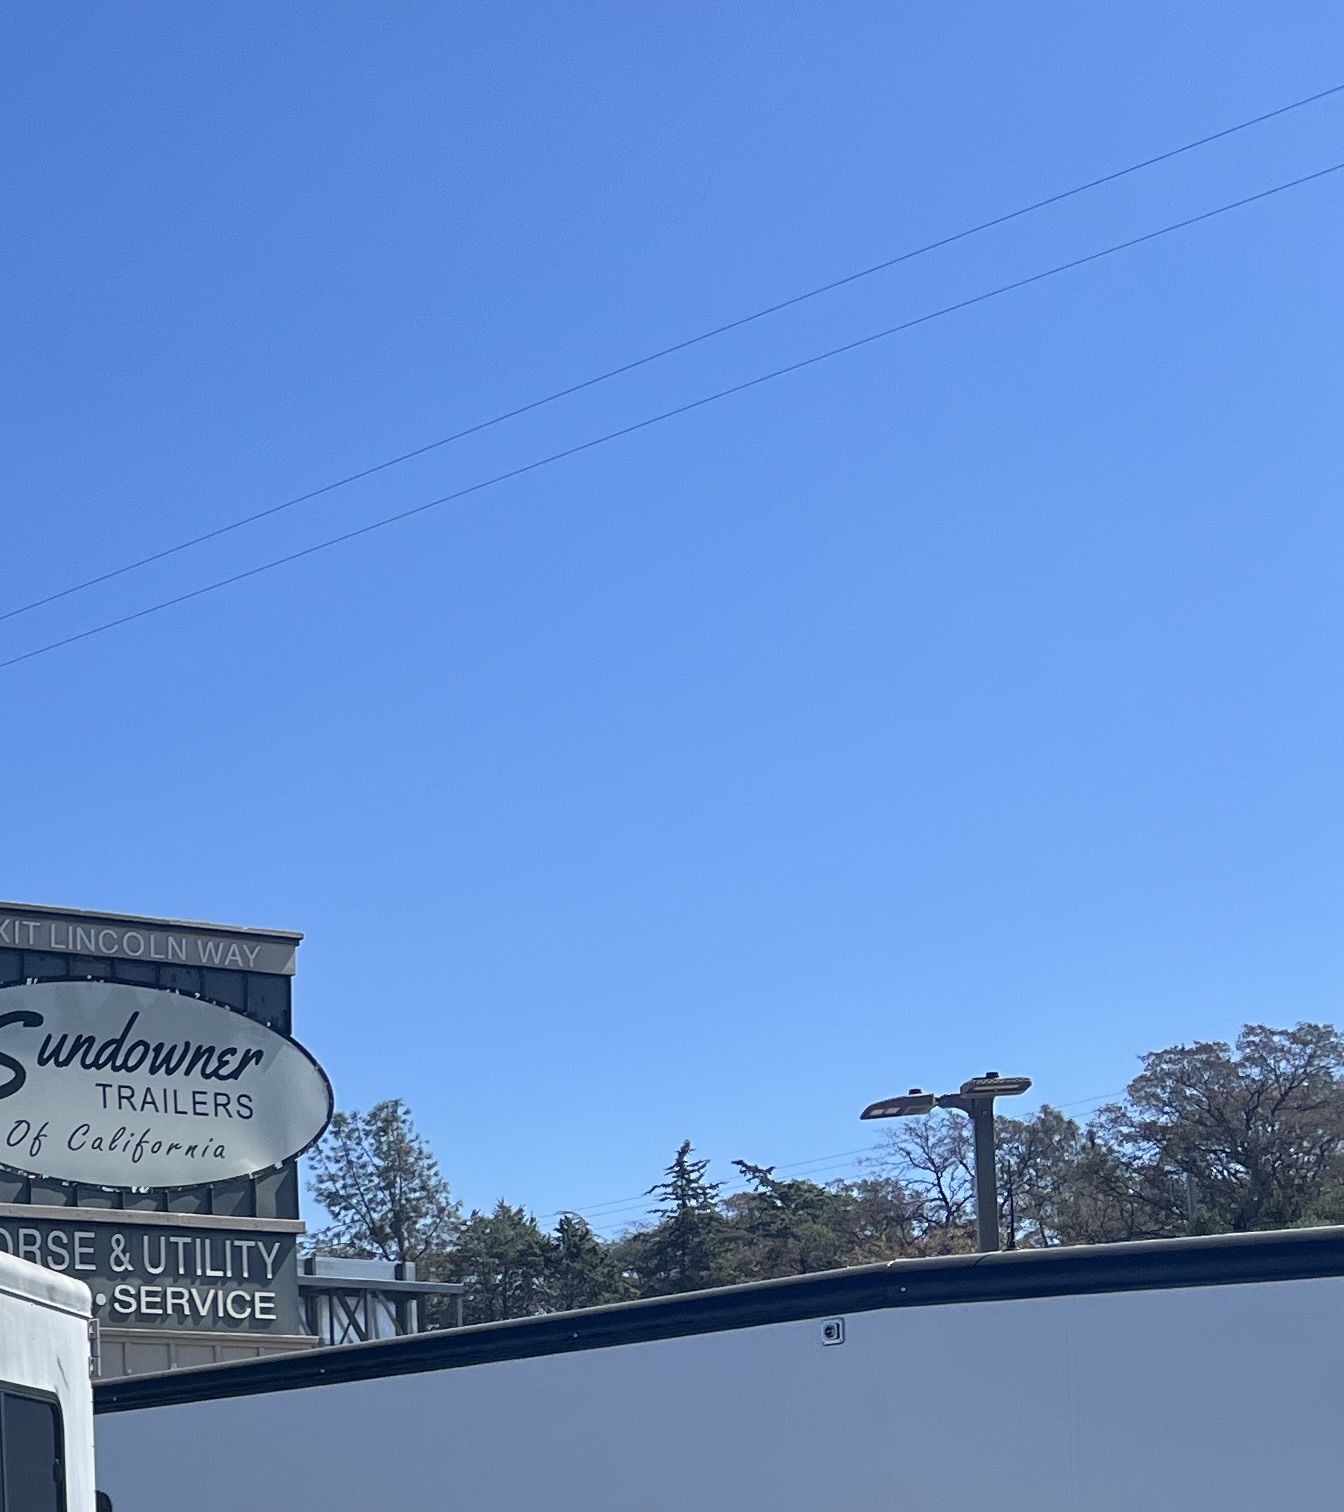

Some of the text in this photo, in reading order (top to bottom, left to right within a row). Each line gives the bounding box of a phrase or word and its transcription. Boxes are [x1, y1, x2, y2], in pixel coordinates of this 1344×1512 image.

[50, 923, 187, 961] LINCOLN
[197, 938, 261, 968] WAY
[95, 1082, 254, 1120] TRAILERS
[6, 1119, 227, 1163] Of California
[109, 1233, 134, 1272] &
[143, 1234, 281, 1279] UTILITY
[113, 1284, 278, 1320] SERVICE
